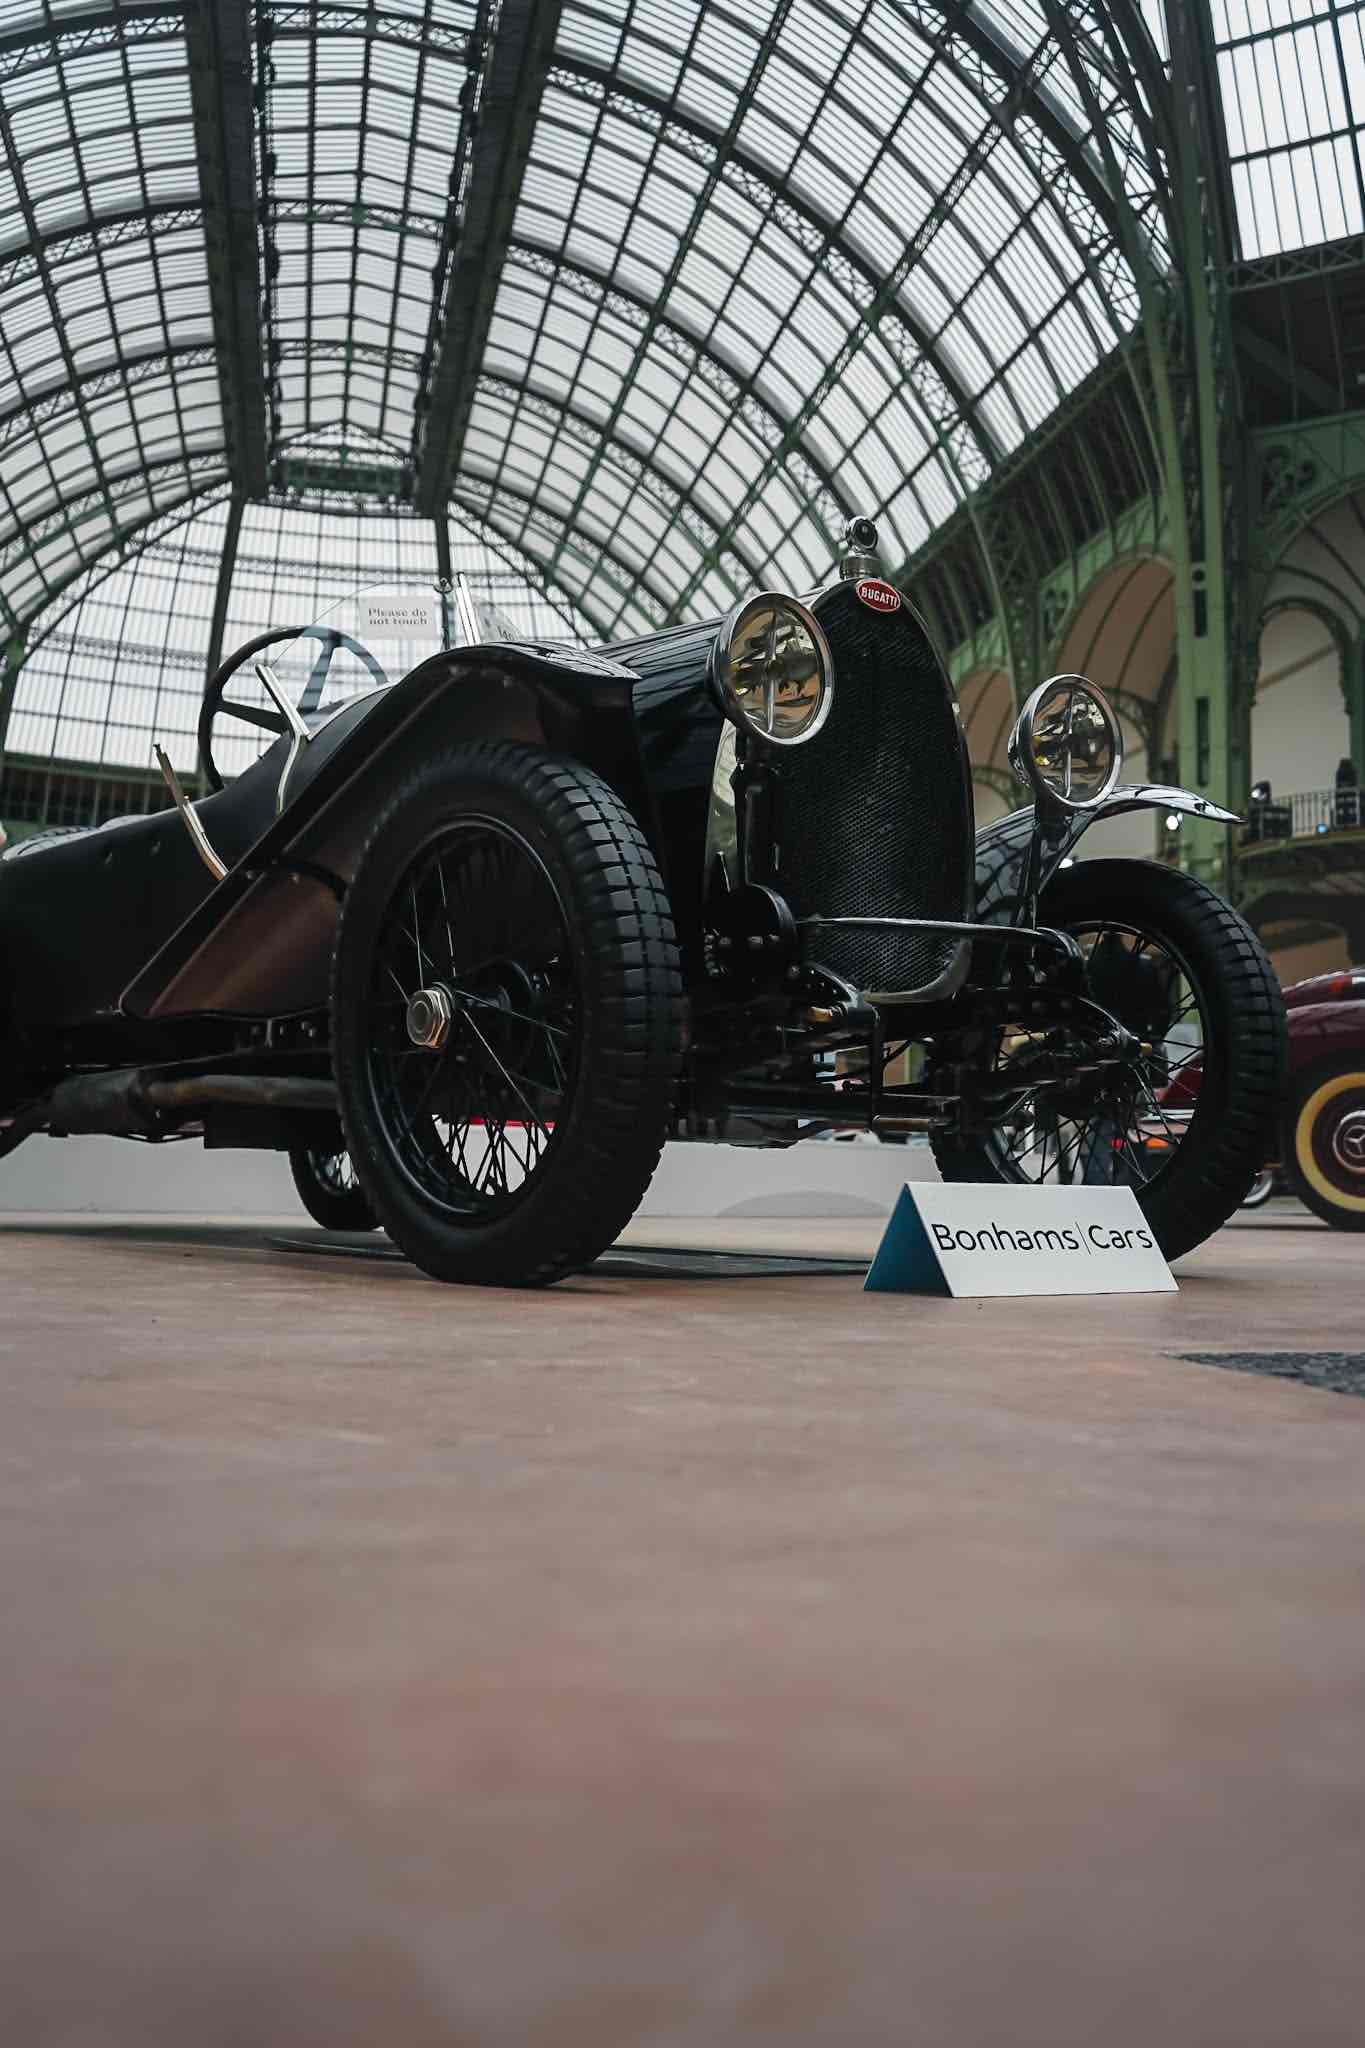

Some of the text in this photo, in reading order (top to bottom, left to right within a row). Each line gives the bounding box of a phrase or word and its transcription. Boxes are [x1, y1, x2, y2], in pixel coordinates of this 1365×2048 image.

[861, 586, 897, 607] BUGATTI
[368, 607, 427, 616] Please do
[369, 616, 428, 625] not touch
